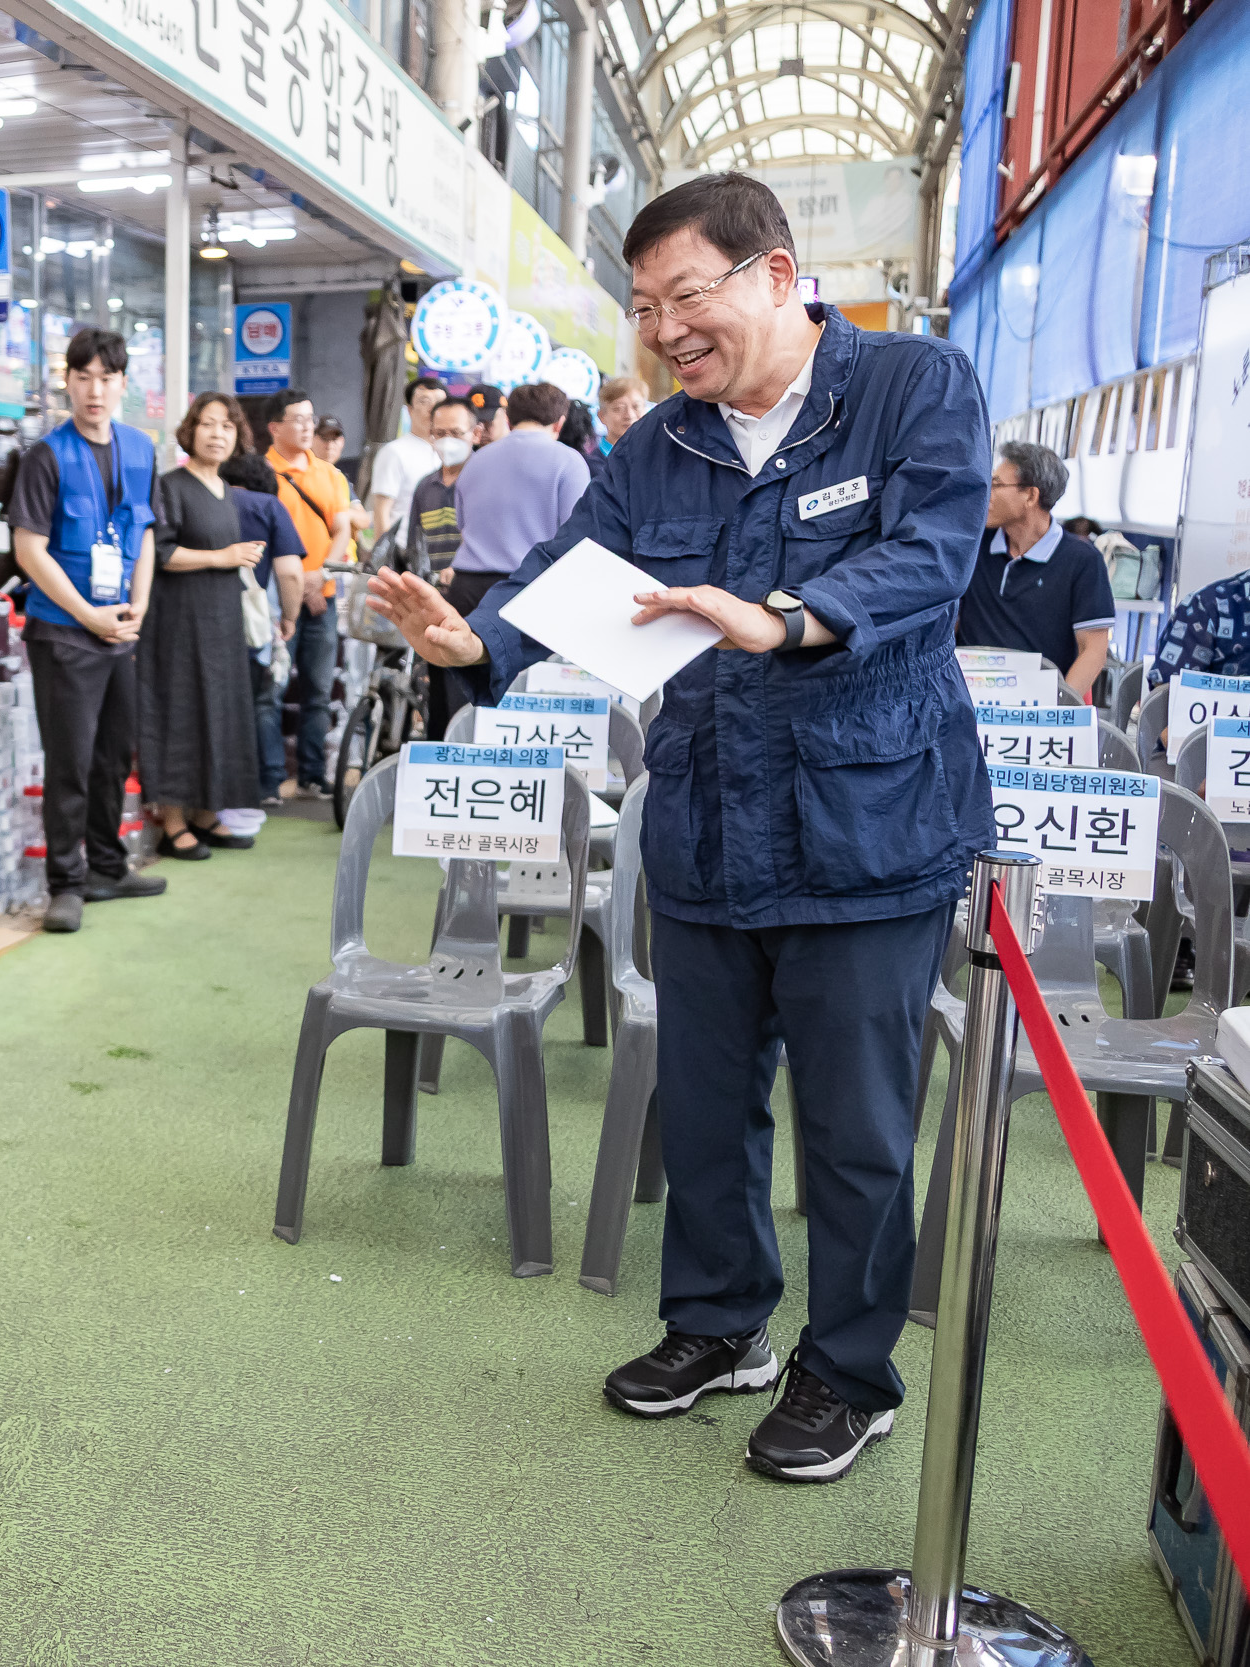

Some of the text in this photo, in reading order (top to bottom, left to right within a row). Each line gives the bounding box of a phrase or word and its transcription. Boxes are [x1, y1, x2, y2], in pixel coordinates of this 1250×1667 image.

[501, 694, 565, 711] 광진구의회
[570, 698, 595, 712] 의원
[1046, 709, 1075, 725] 의원
[435, 745, 550, 766] 광진구의회 의장
[424, 776, 546, 823] 전은혜
[993, 803, 1137, 855] 오신환
[424, 833, 540, 854] 노룬산 골목시장
[1047, 867, 1126, 891] 골목시장
